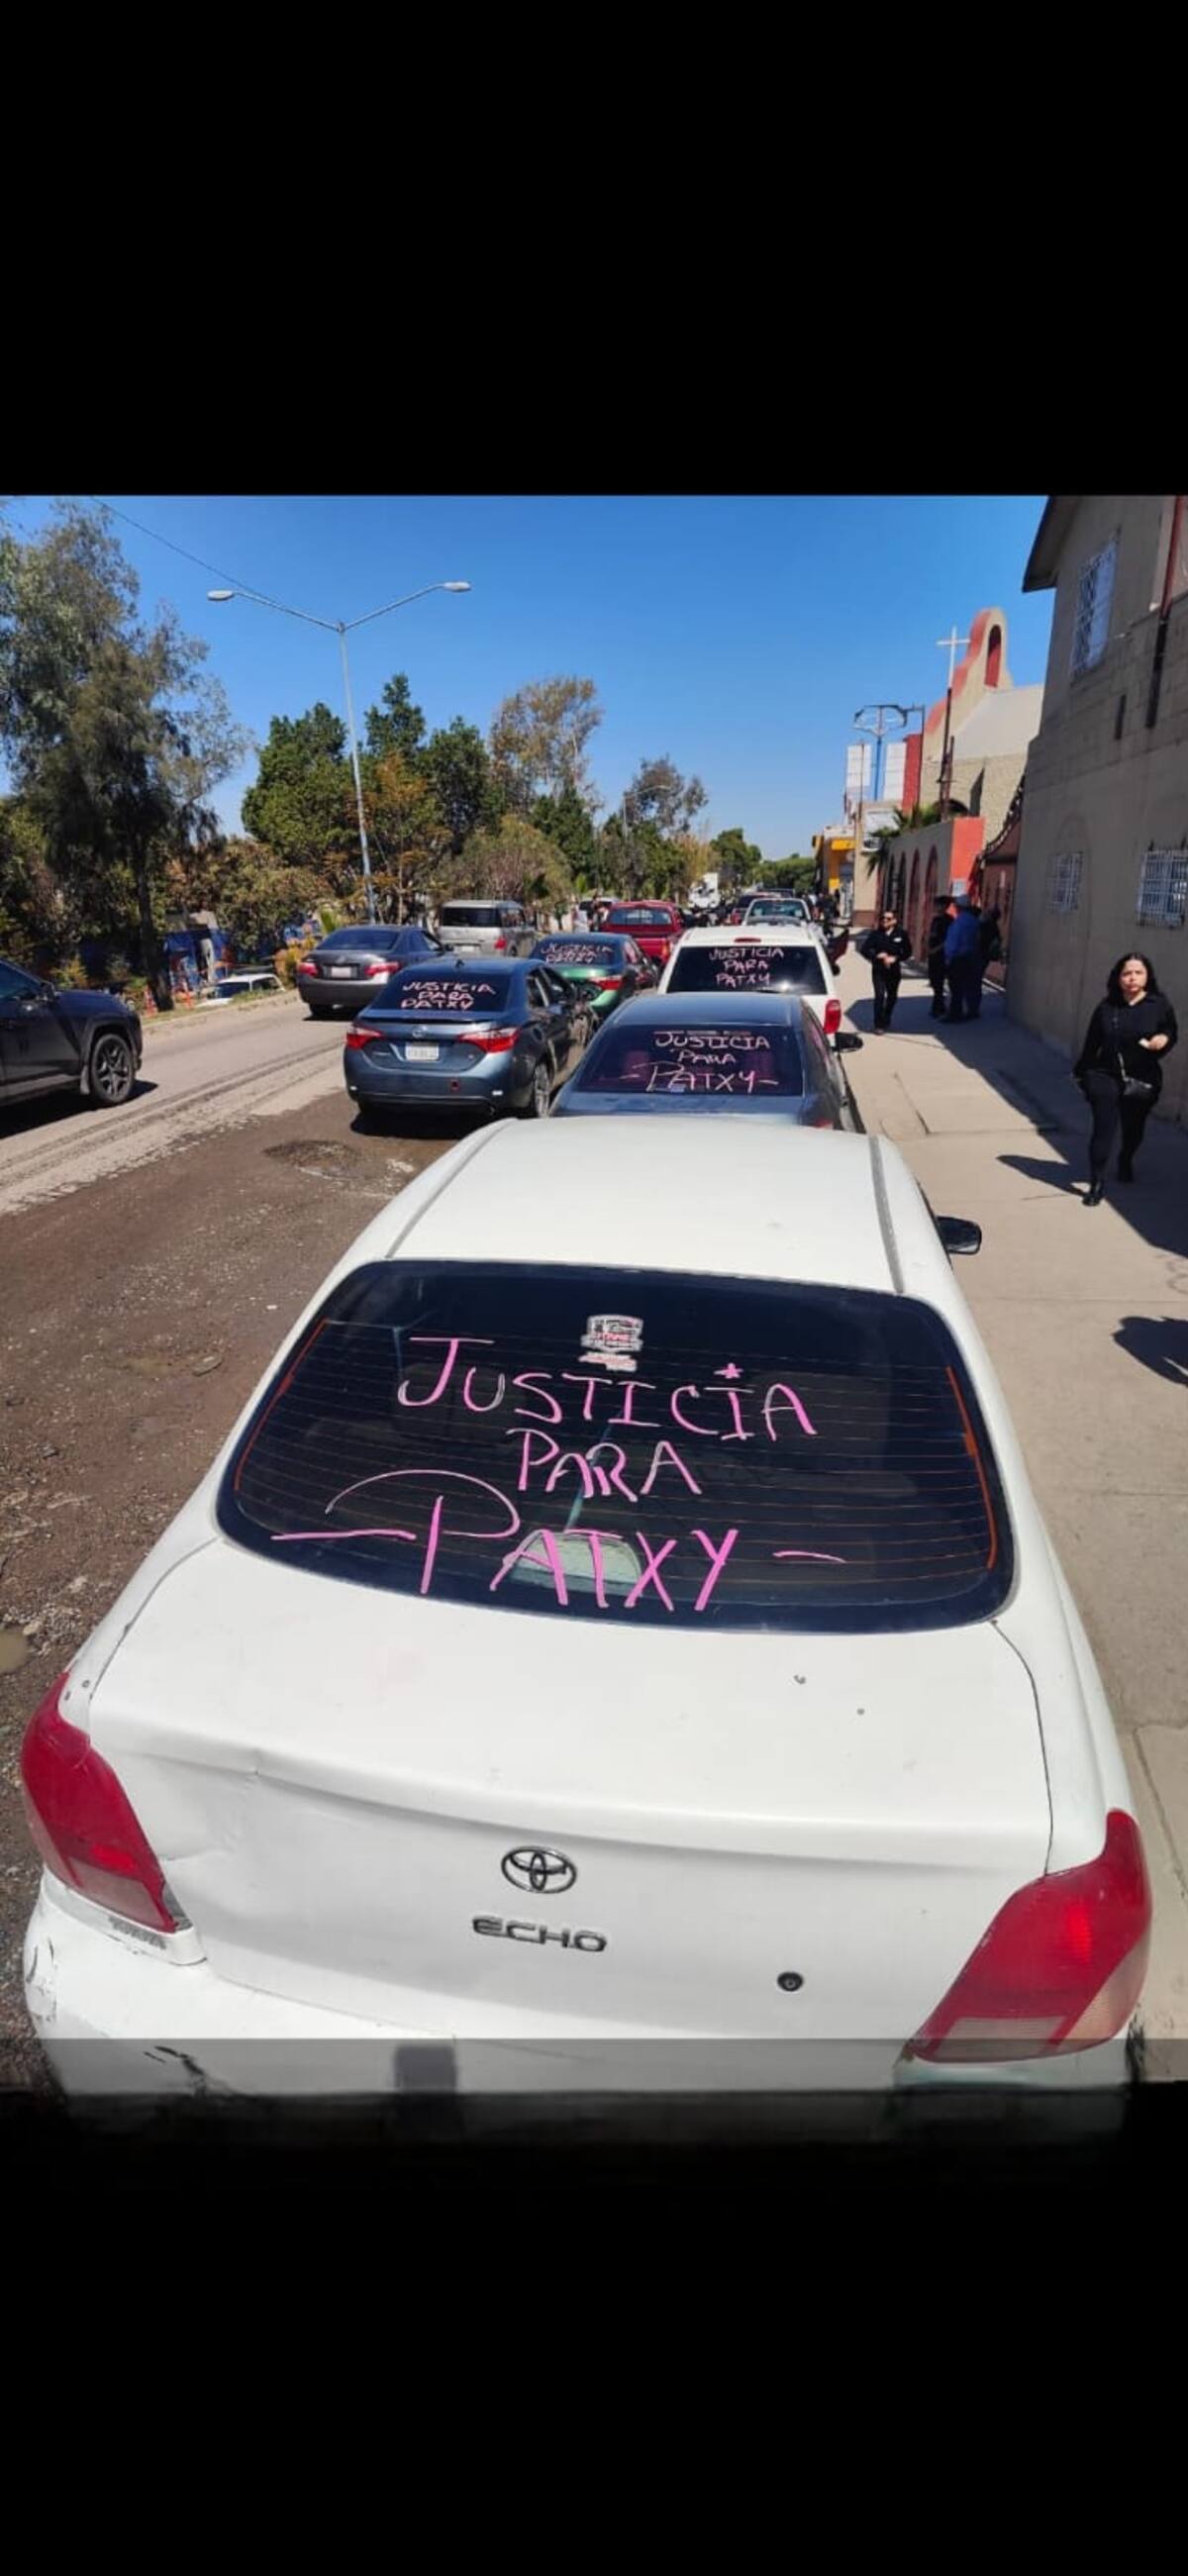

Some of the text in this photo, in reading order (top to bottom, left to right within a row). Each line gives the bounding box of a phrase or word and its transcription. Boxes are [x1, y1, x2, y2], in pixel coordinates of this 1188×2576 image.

[709, 947, 784, 960] JUSTICIA
[723, 959, 769, 973] PARA
[402, 981, 496, 994] JUSTICIA
[716, 972, 771, 988] PATXY
[418, 991, 474, 1001] PARA
[401, 998, 474, 1010] PATXY
[654, 1031, 770, 1049] JUSTICIA
[677, 1049, 737, 1064] PARA
[398, 1337, 818, 1440] JUSTICIA
[507, 1429, 702, 1504] PARA
[472, 1916, 608, 1952] ECHO
